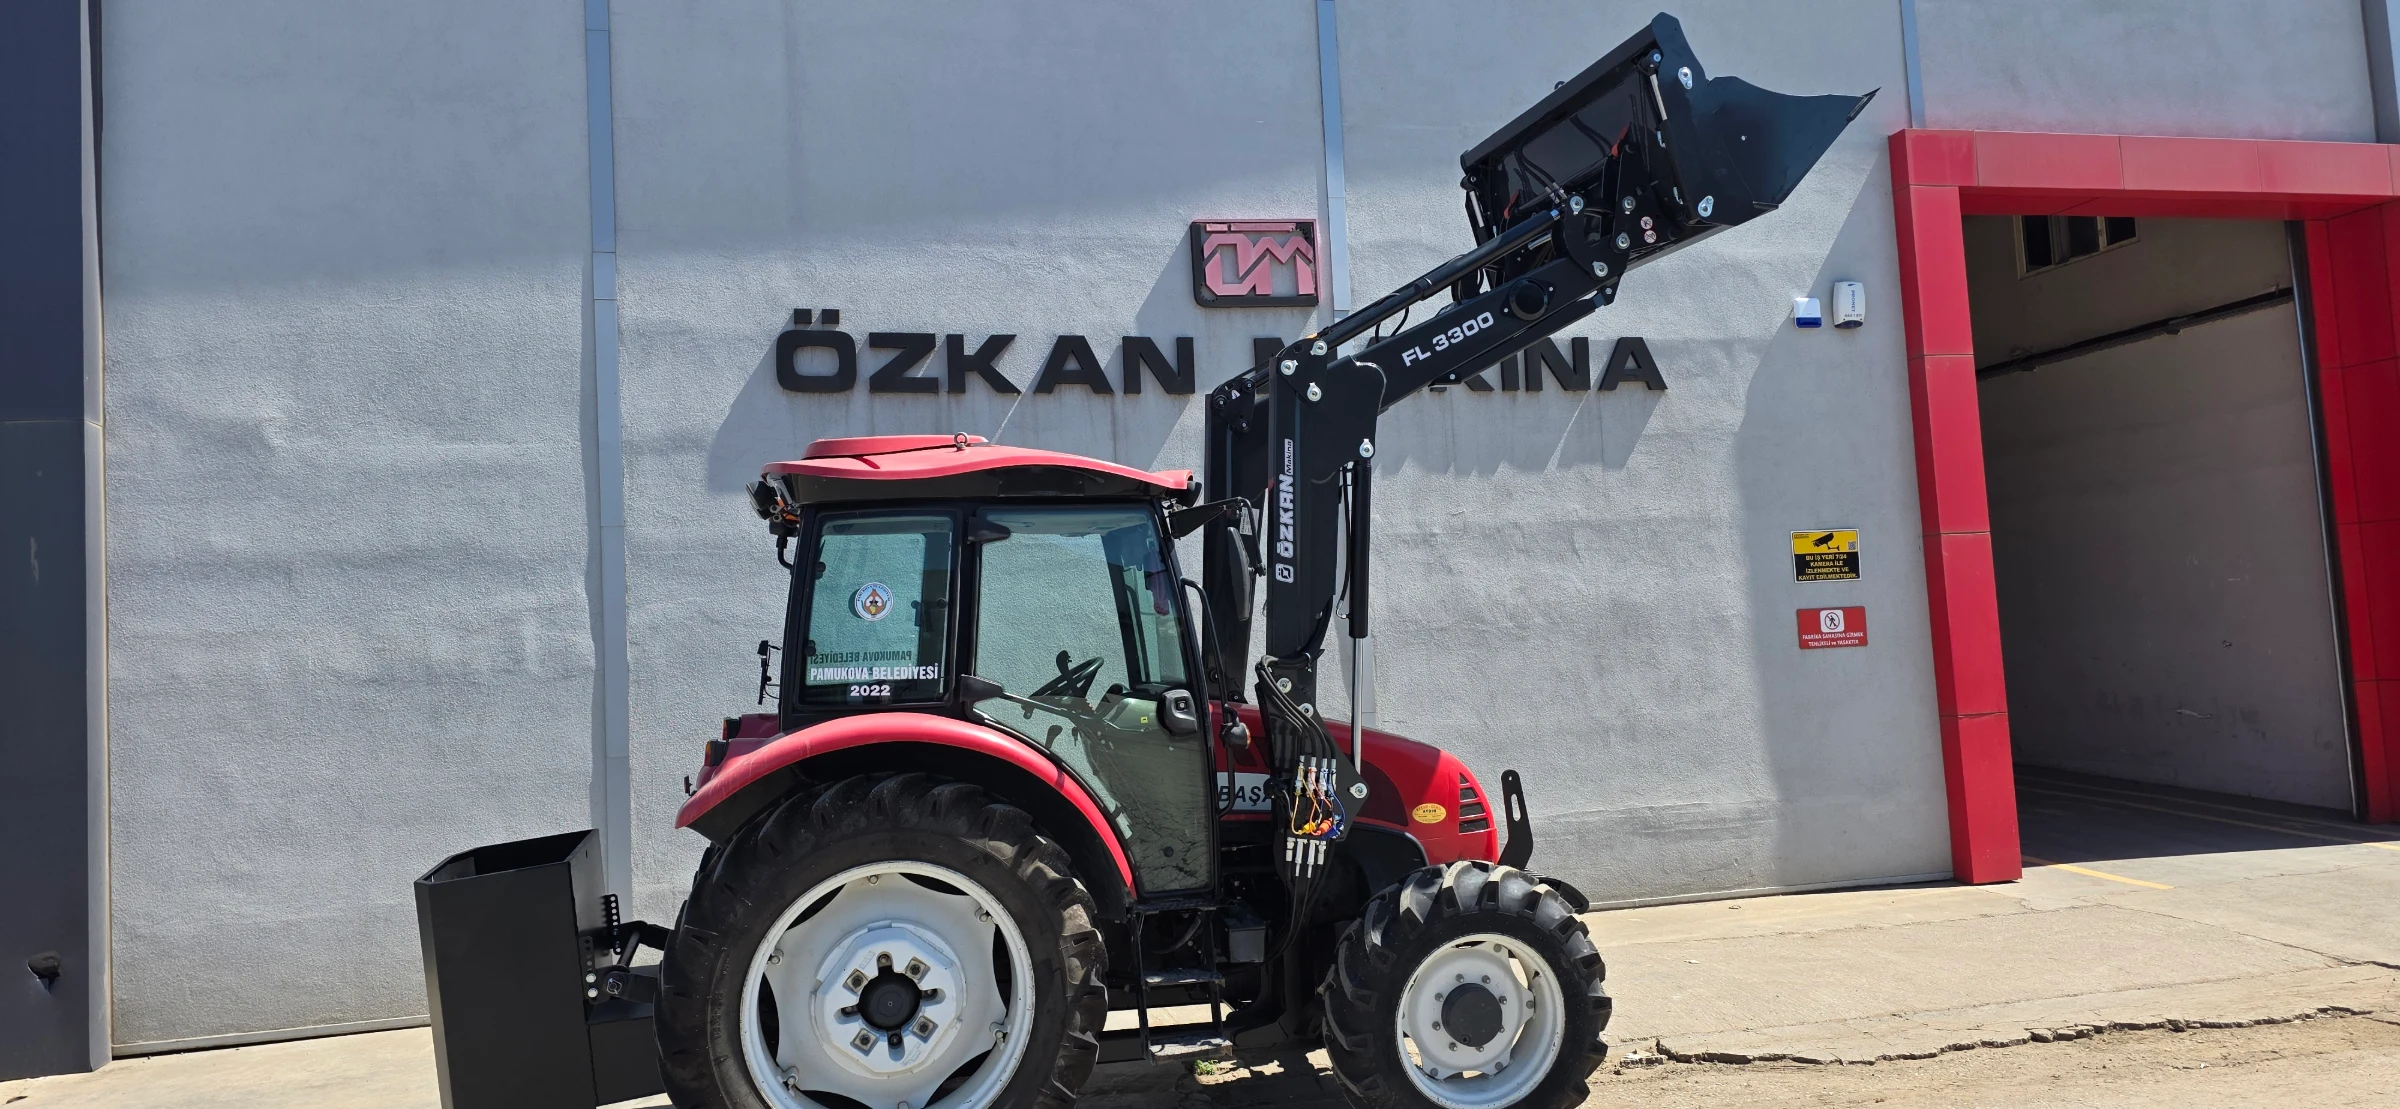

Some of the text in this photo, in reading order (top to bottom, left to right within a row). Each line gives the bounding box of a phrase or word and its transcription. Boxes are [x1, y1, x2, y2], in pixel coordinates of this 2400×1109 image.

[776, 308, 1668, 395] ÖZKAN INA
[1402, 312, 1494, 367] FL 3300
[1285, 440, 1293, 474] Makina
[1277, 473, 1294, 559] ÖZKAN
[810, 662, 939, 681] PAMUKOVA BELEDİYESİ
[850, 685, 891, 697] 2022
